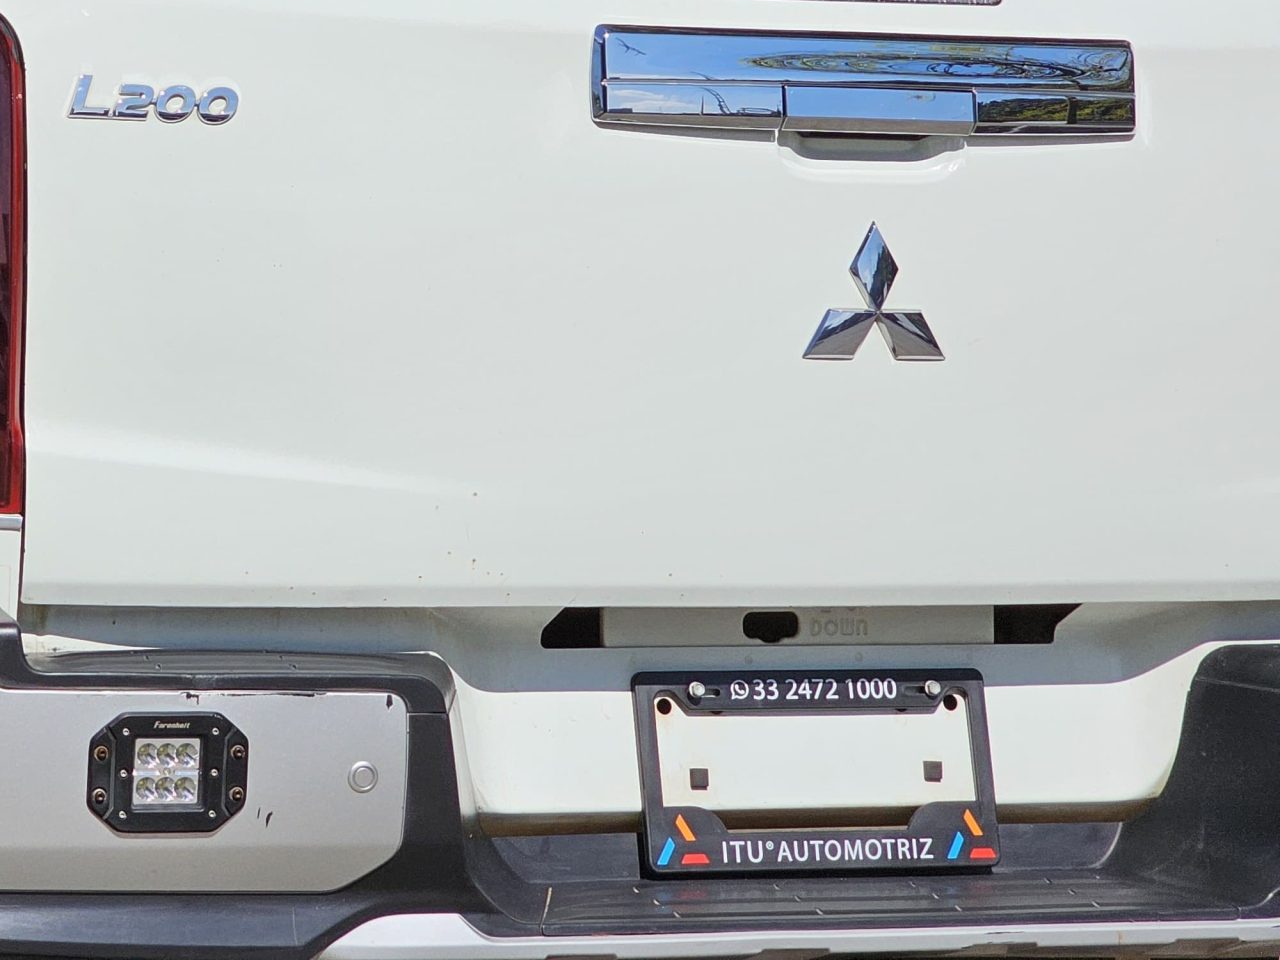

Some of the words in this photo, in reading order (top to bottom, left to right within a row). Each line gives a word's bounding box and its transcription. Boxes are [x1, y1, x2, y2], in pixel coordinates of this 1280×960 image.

[67, 74, 239, 126] L200
[752, 679, 780, 700] 33
[785, 678, 839, 700] 2472
[845, 677, 897, 700] 1000
[777, 838, 935, 863] AUTOMOTRIZ
